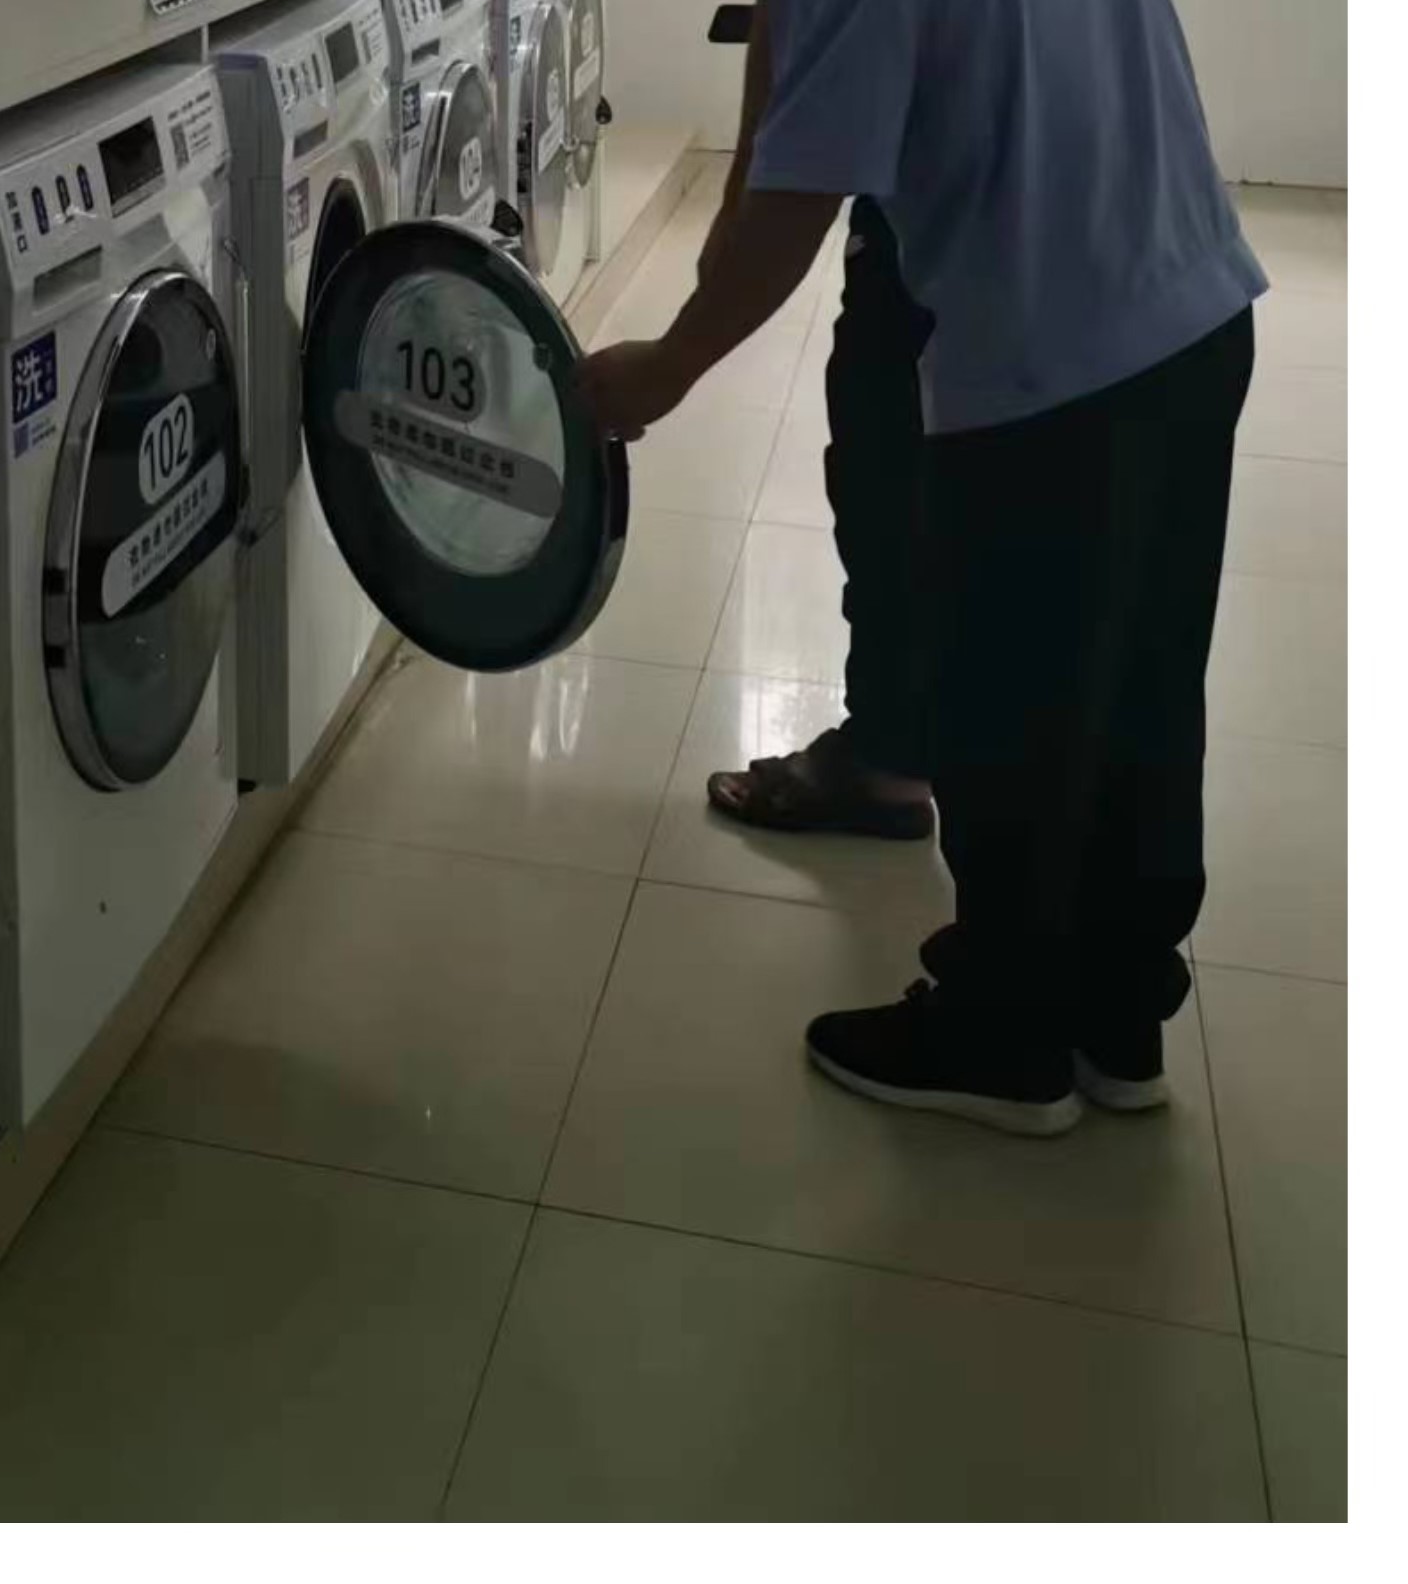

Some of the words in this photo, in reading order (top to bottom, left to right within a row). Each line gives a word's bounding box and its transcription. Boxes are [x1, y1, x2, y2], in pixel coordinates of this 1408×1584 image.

[14, 348, 44, 412] 洗
[397, 340, 475, 412] 103
[144, 405, 188, 491] 102
